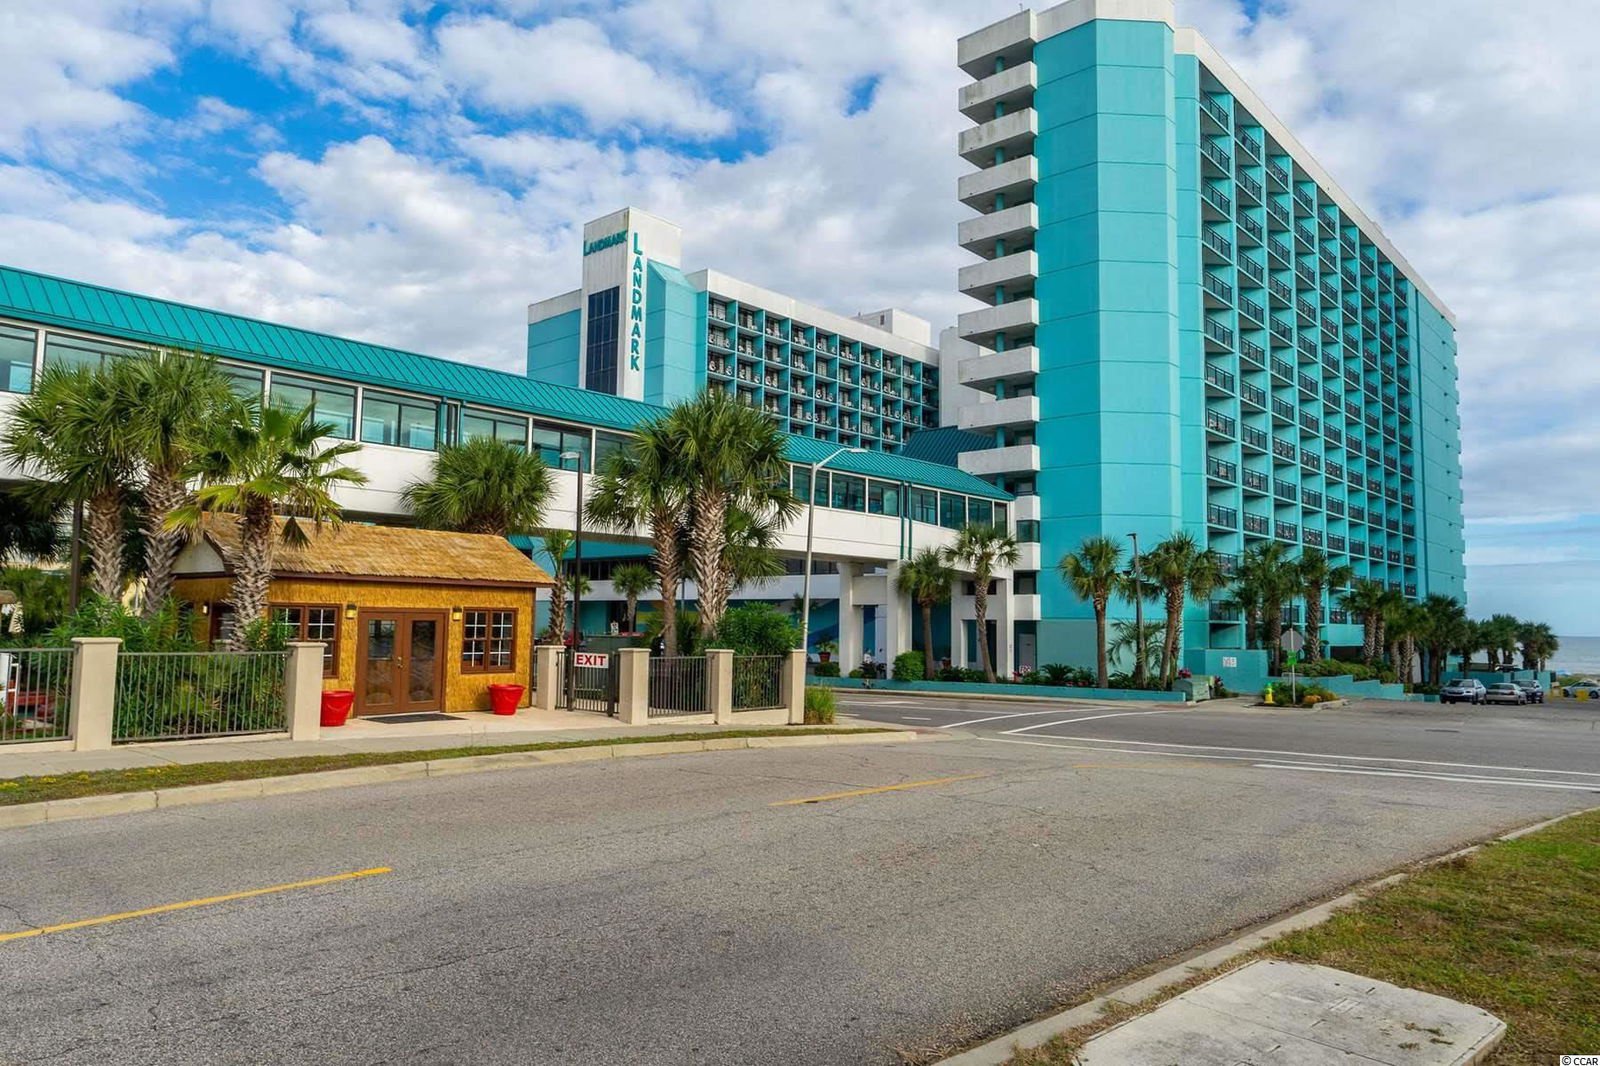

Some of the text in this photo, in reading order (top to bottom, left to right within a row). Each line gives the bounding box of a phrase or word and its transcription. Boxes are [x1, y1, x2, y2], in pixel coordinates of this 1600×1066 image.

[584, 229, 628, 256] LANDMARK
[630, 232, 643, 372] LANDMARK
[576, 654, 606, 666] EXIT
